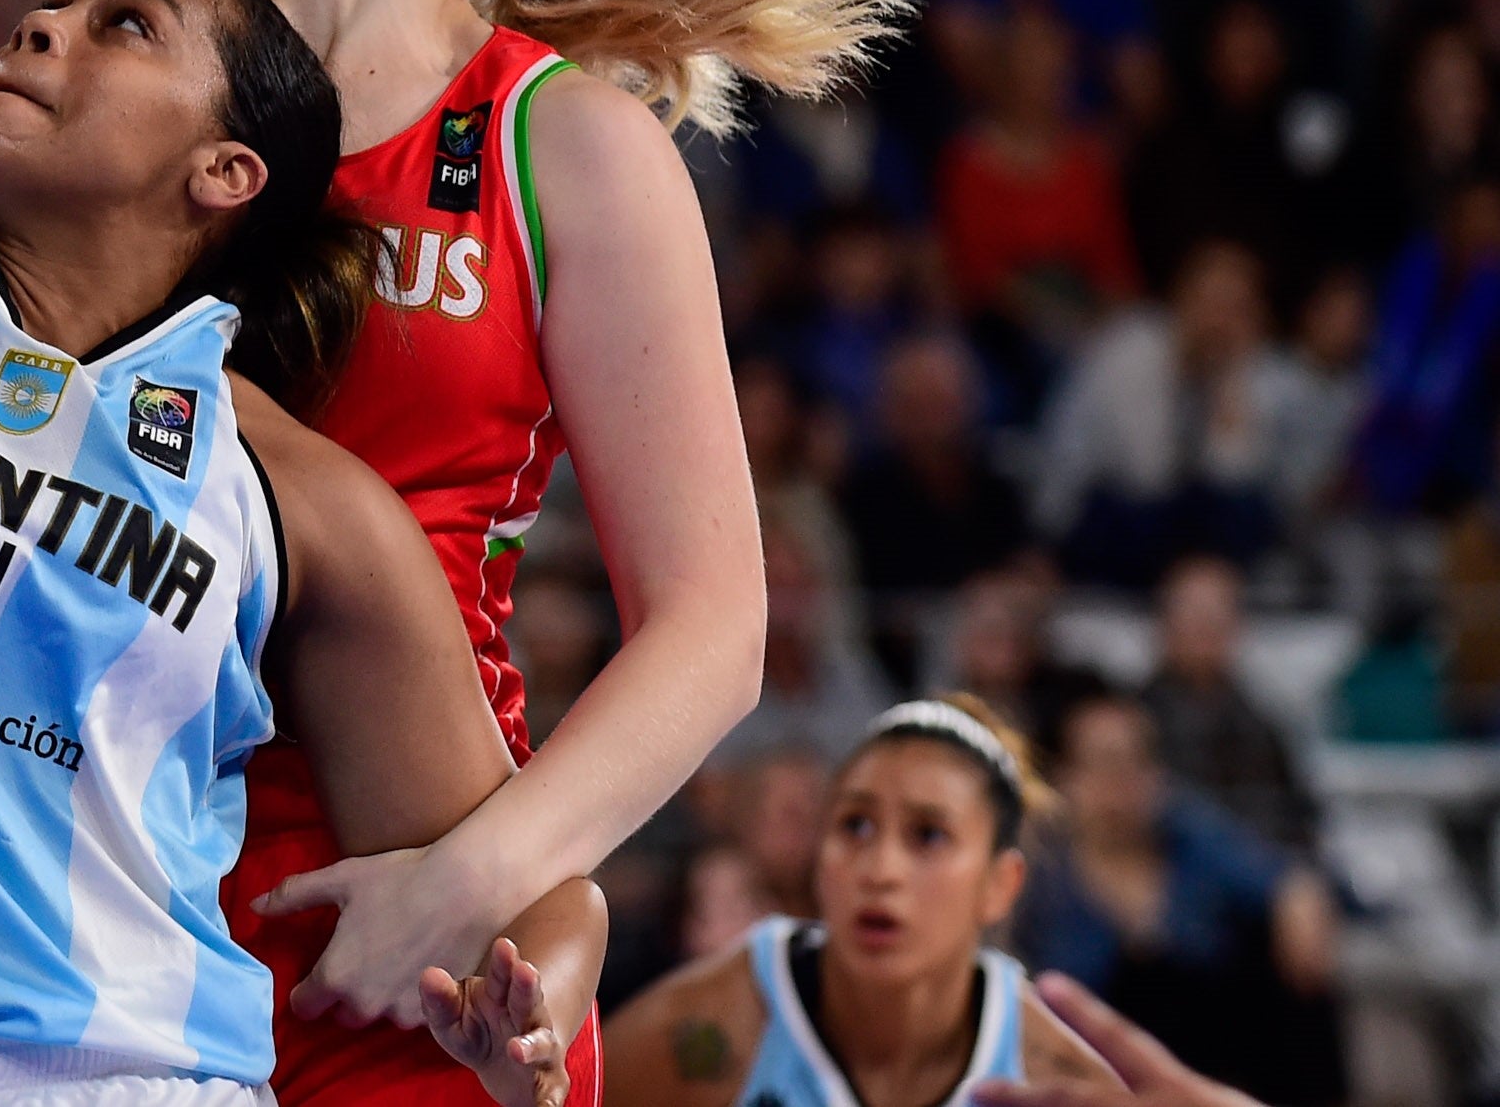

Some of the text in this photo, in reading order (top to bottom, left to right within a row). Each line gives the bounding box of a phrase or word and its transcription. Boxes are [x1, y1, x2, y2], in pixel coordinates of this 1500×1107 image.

[441, 163, 477, 186] FIBA
[372, 222, 489, 322] US
[14, 354, 62, 372] CABB
[138, 422, 183, 451] FIBA
